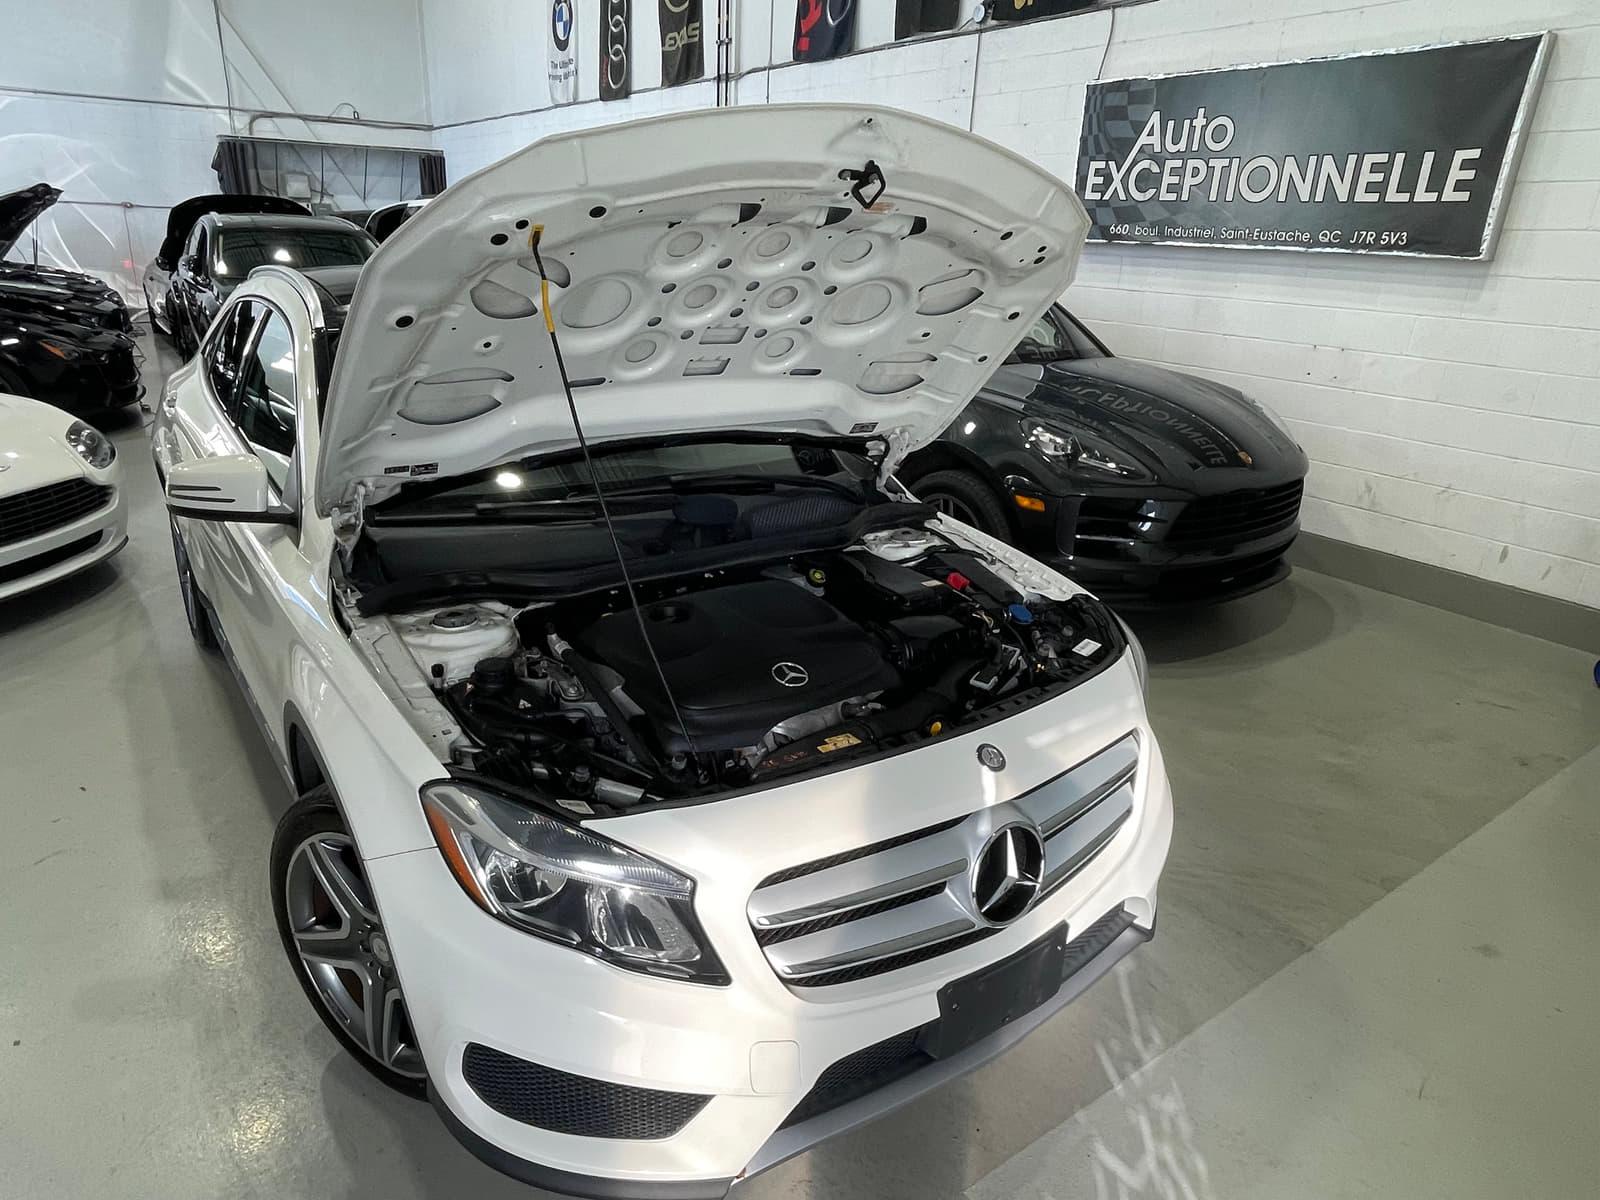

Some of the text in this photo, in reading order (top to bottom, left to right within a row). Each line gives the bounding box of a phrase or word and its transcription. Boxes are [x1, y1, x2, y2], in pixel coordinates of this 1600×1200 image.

[1136, 107, 1234, 152] Auto
[1084, 147, 1482, 203] EXCEPTIONNELLE
[1164, 225, 1217, 239] Industriel,
[1220, 227, 1313, 243] Saint-Eustache,
[1318, 230, 1342, 243] QC
[1350, 231, 1376, 244] J7R
[1380, 232, 1408, 245] 5V3
